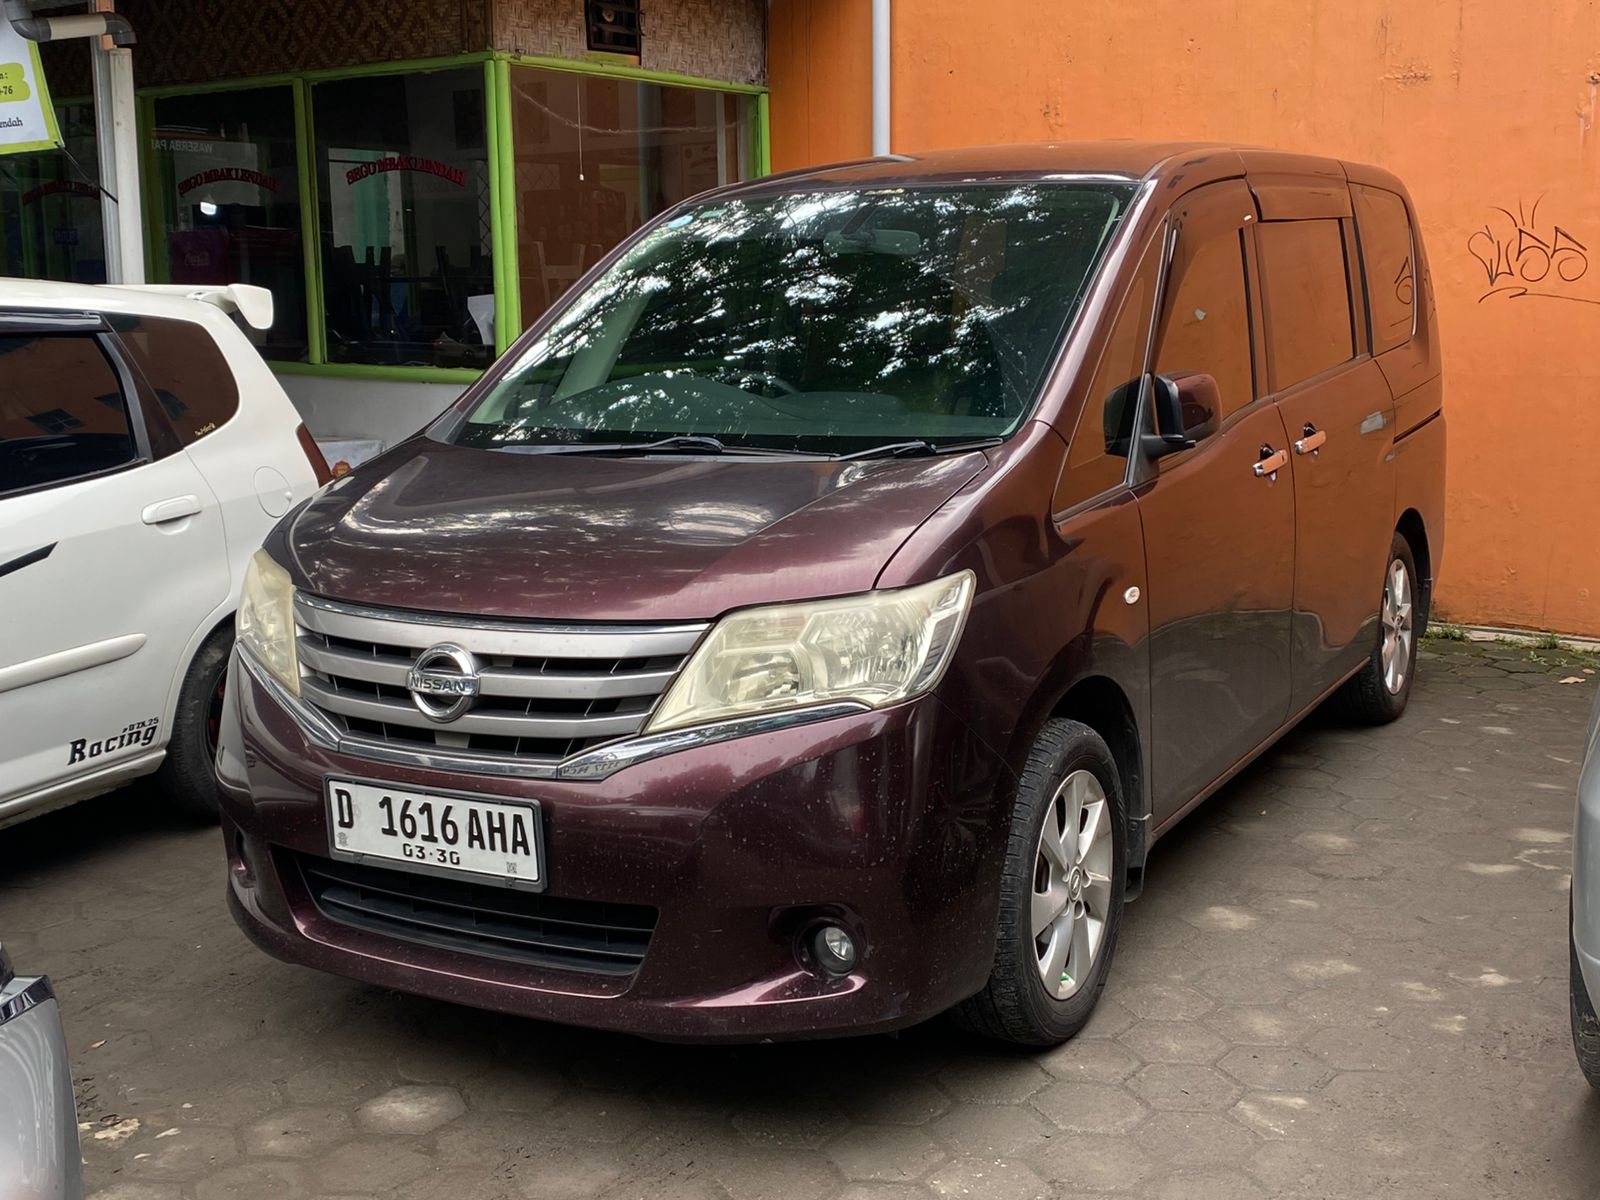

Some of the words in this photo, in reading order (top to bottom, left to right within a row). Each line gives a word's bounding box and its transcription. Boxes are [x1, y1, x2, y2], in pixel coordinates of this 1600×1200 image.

[0, 85, 13, 95] -76
[411, 676, 466, 692] NISSAN
[67, 725, 158, 766] Racing
[335, 788, 354, 829] D
[379, 796, 459, 846] 1616
[468, 808, 530, 856] AHA
